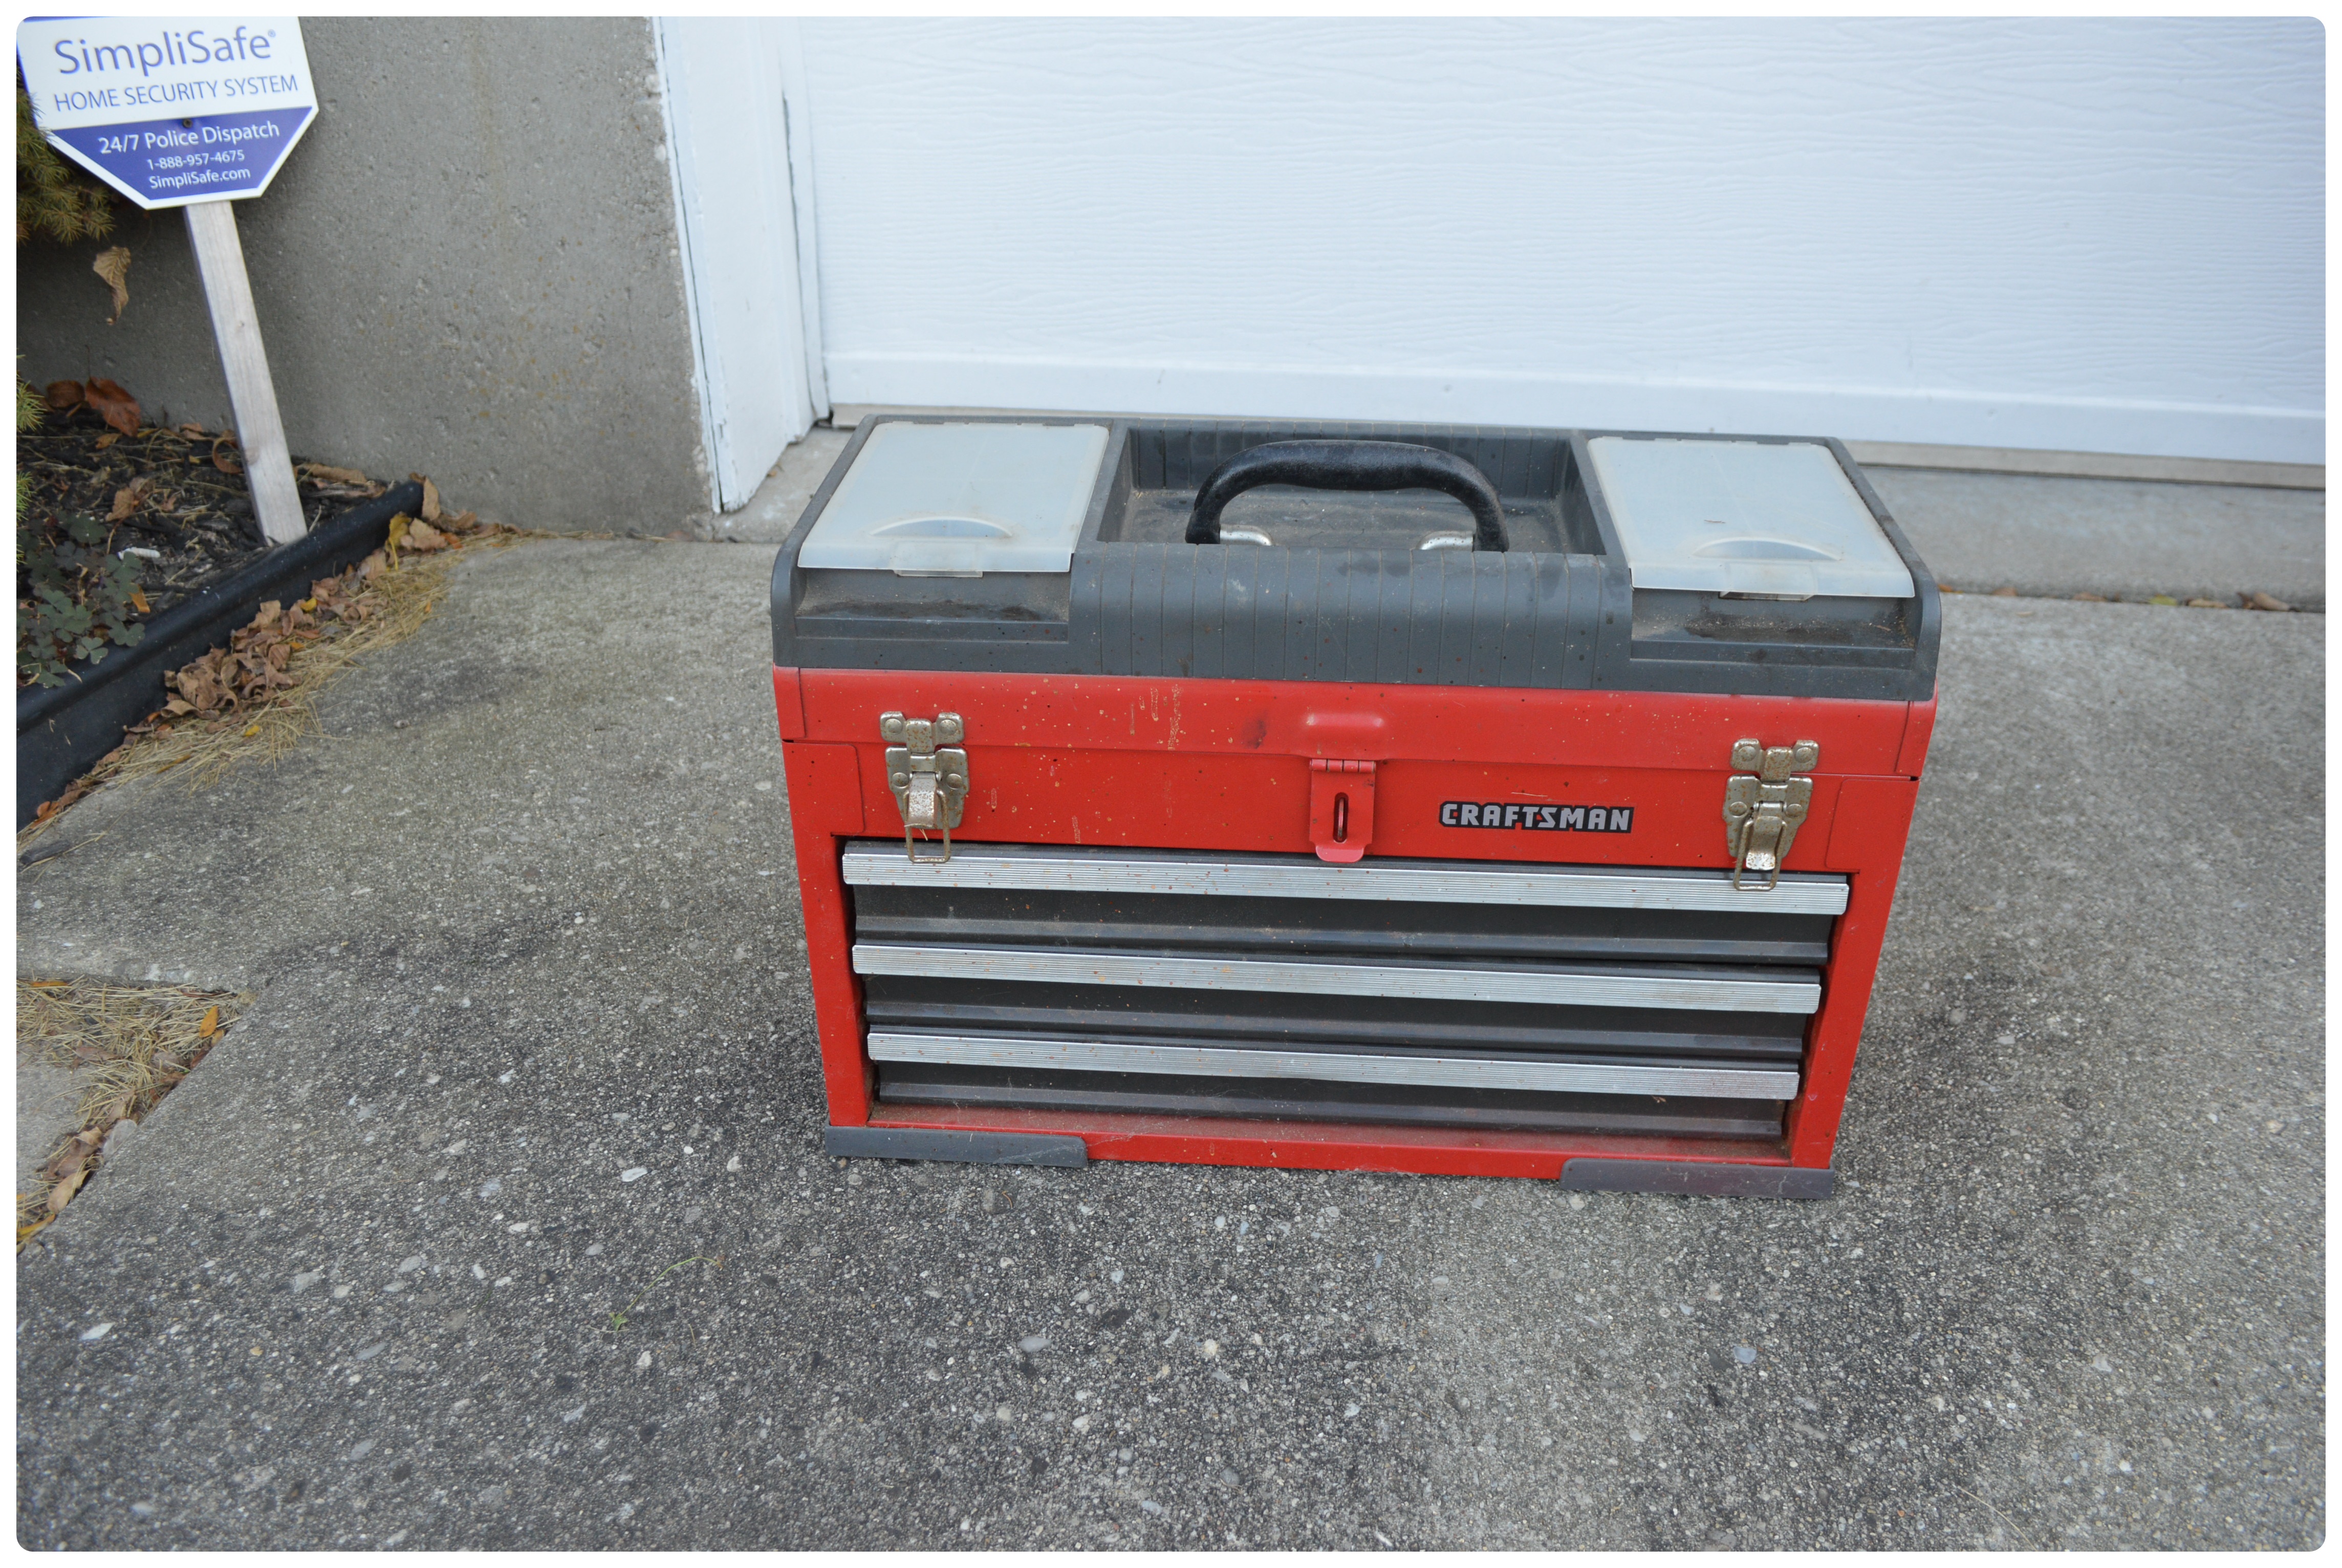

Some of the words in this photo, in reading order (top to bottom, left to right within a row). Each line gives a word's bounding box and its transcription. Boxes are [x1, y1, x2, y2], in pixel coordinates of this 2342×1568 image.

[54, 89, 120, 112] HOME
[124, 80, 218, 105] SECURITY
[225, 74, 298, 96] SYSTEM
[98, 134, 139, 155] 24/7
[146, 130, 199, 149] Police
[204, 121, 279, 145] Dispatch
[147, 149, 245, 170] 1-888-957-4675
[148, 167, 251, 189] SimpliSafe.com
[1442, 803, 1631, 831] CRAFTSMAN
